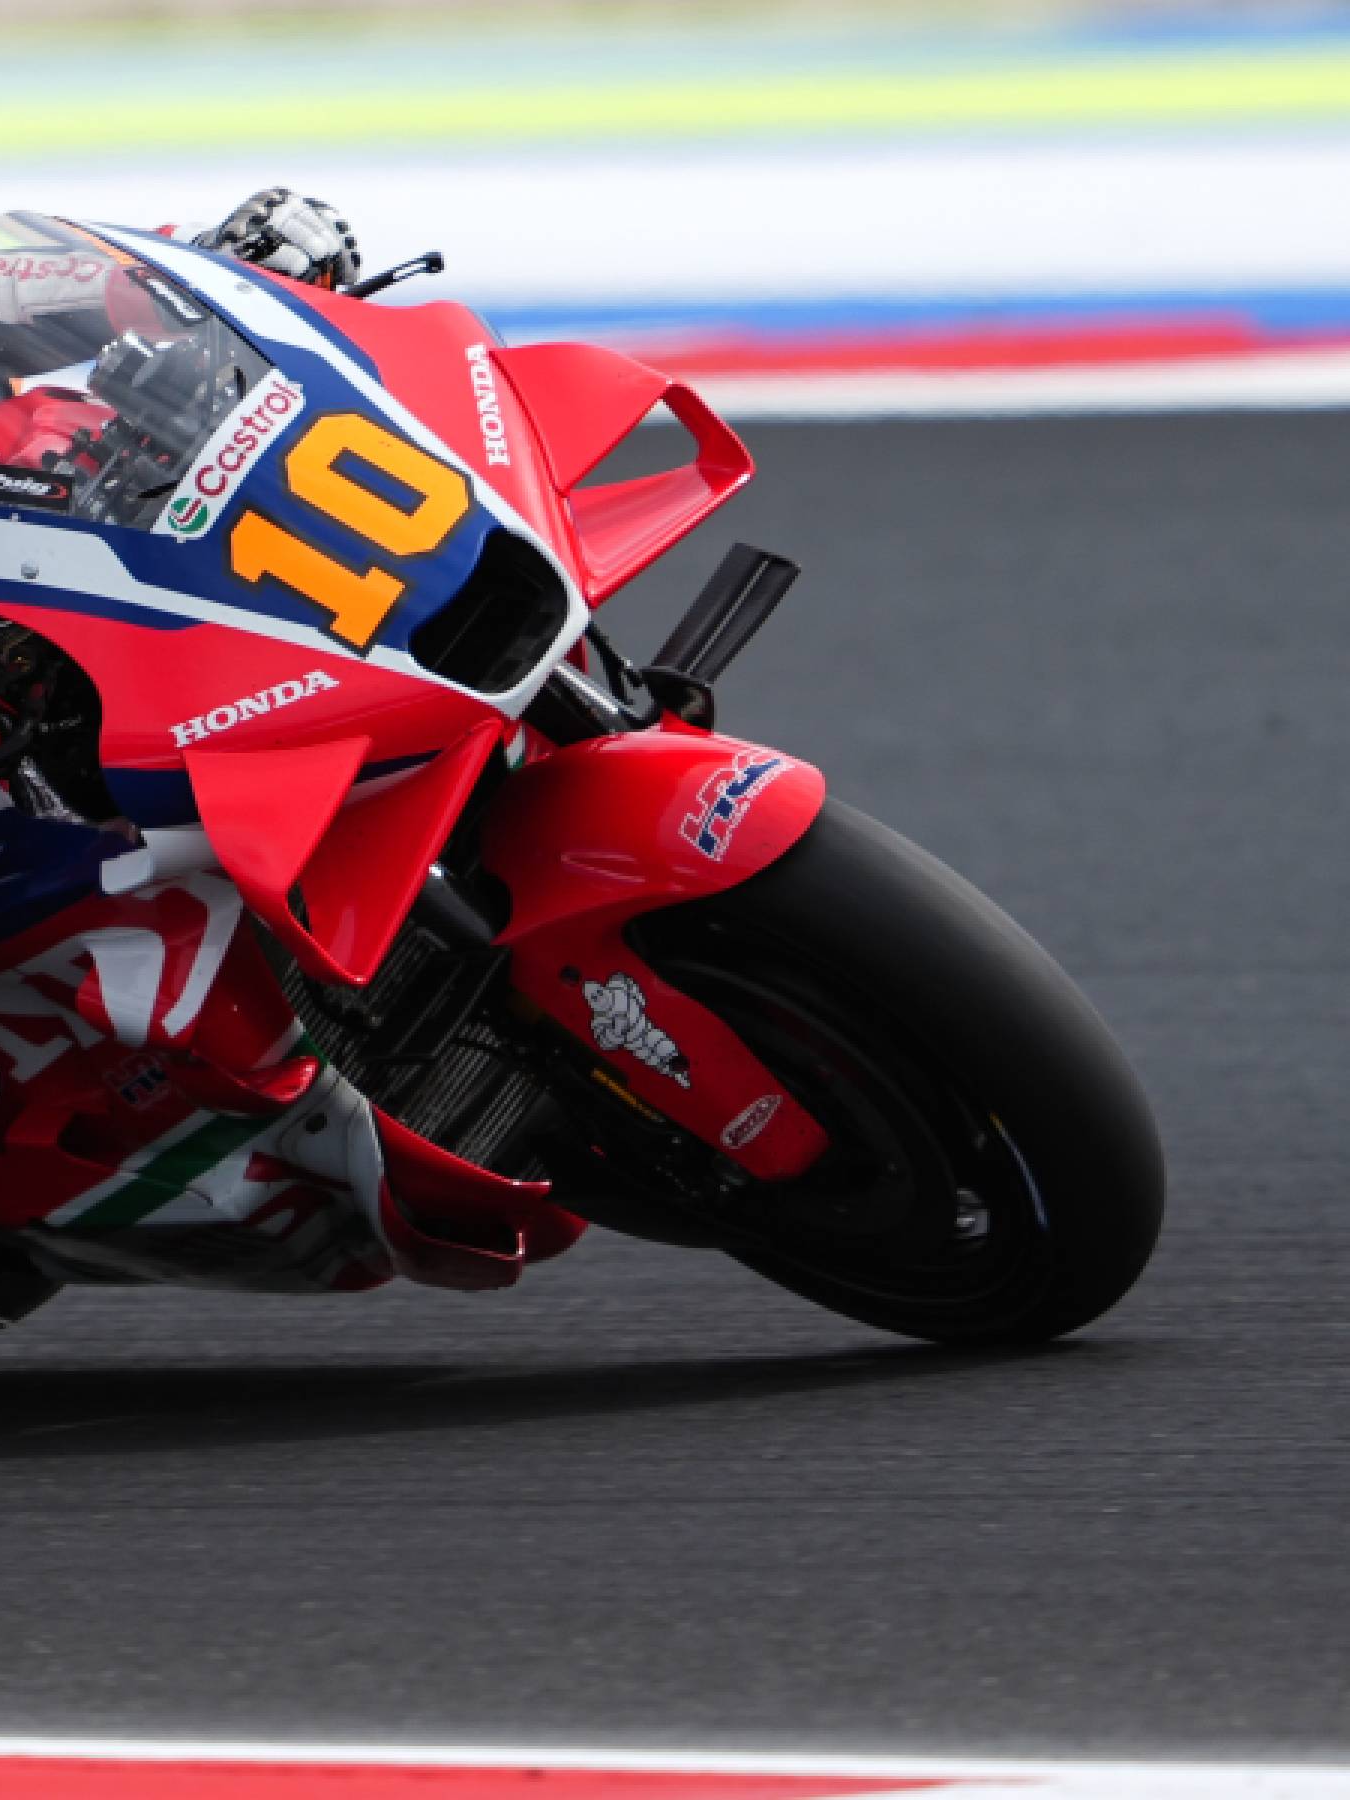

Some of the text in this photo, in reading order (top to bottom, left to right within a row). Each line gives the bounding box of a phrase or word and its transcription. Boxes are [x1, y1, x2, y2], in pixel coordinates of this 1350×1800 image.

[194, 380, 299, 497] Castrol
[464, 343, 511, 467] HONDA
[227, 410, 476, 659] 10
[169, 670, 340, 748] HONDA
